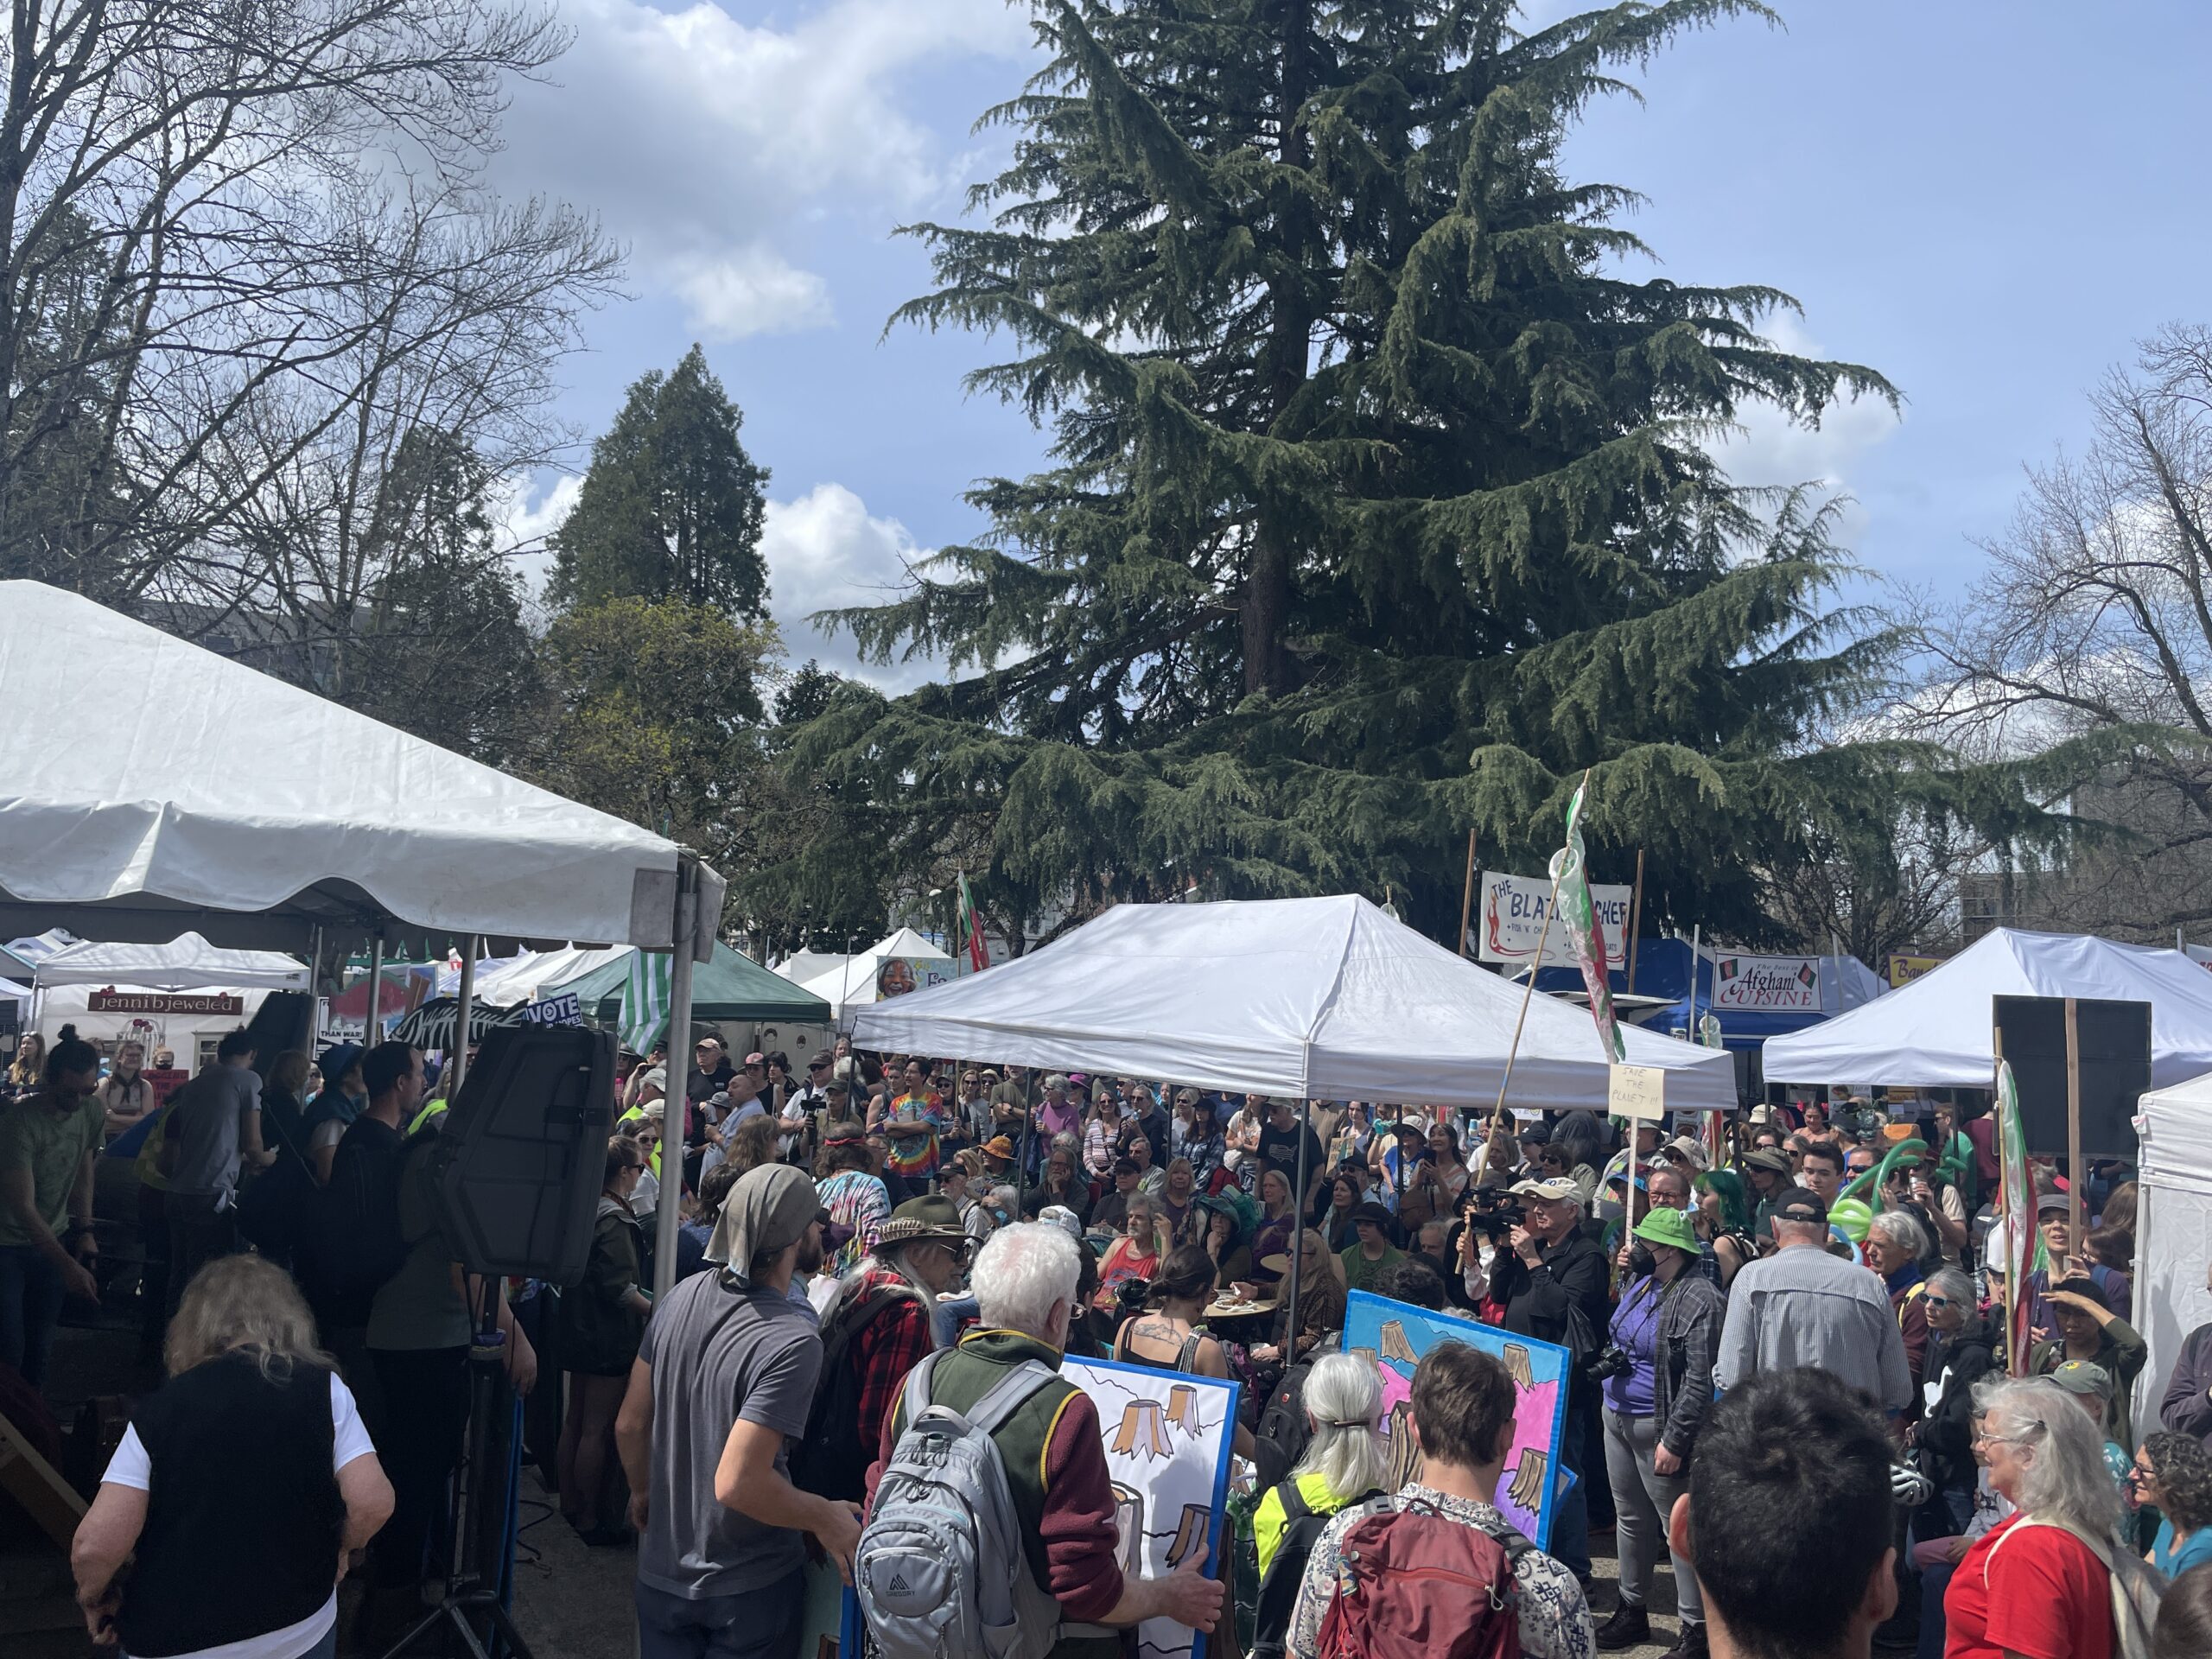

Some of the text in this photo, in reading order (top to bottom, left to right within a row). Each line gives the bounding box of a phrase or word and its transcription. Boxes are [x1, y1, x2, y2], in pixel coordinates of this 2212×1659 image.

[1491, 880, 1513, 900] THE
[1595, 900, 1626, 925] CHEF
[1730, 967, 1796, 995] Afghani
[1720, 989, 1813, 1006] CUISINE
[528, 995, 579, 1023] VOTE
[1622, 1067, 1647, 1077] SAVE
[1625, 1079, 1644, 1090] THE
